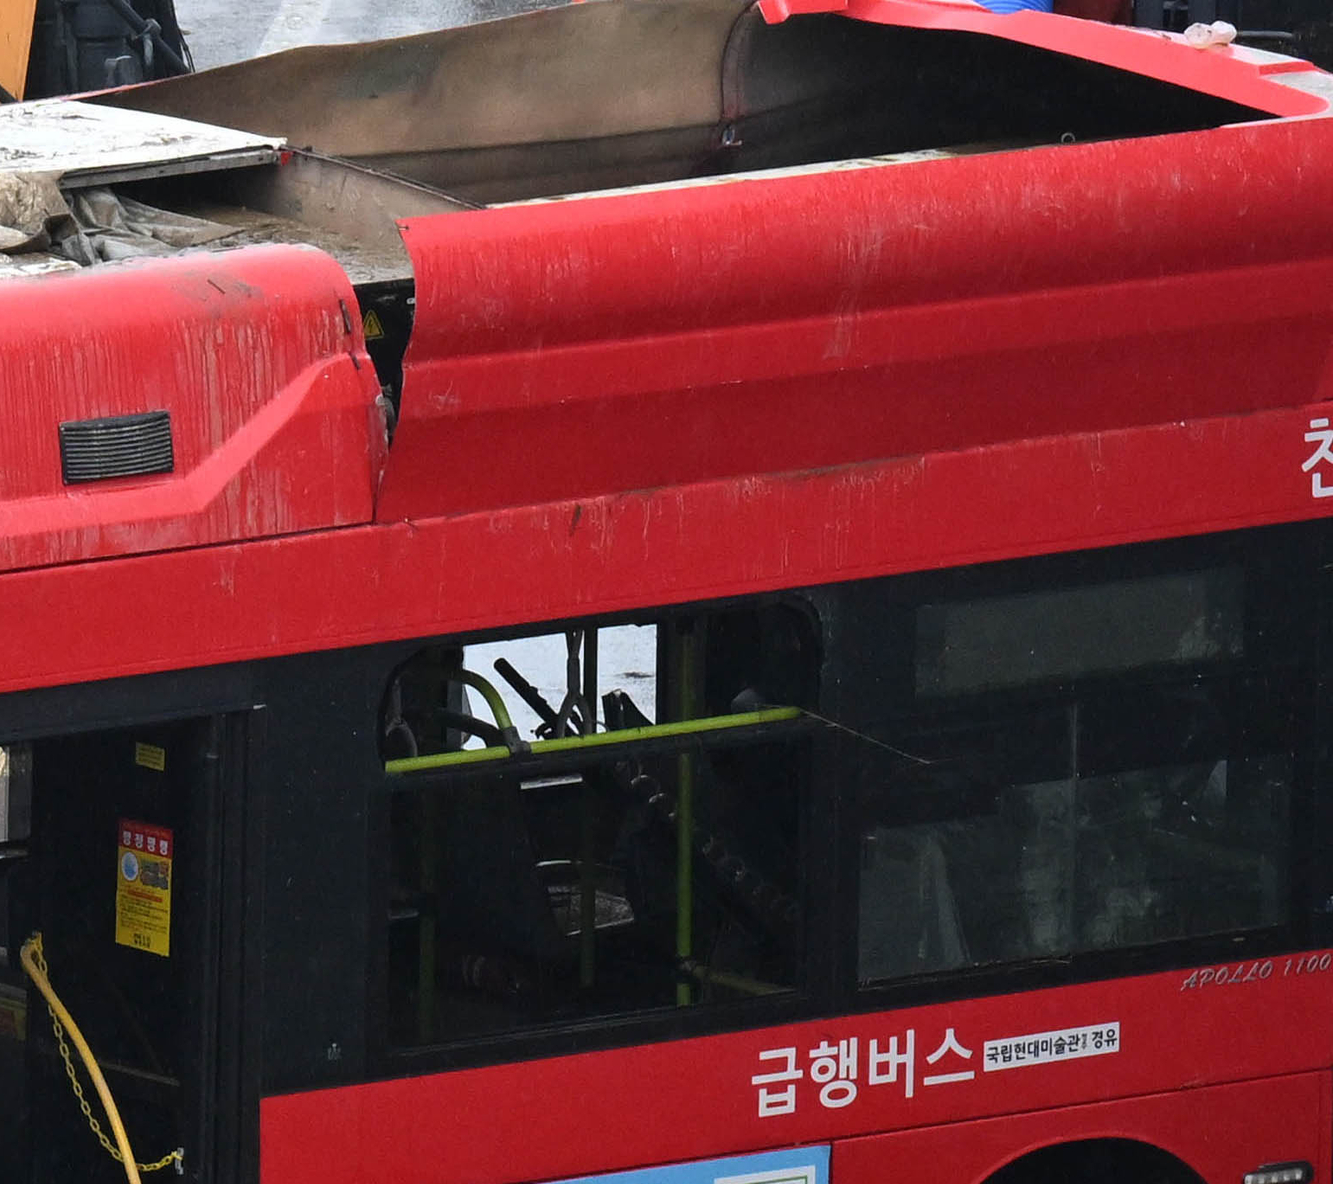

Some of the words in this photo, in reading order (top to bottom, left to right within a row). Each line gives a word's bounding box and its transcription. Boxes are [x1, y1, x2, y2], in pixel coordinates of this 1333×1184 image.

[1181, 960, 1273, 991] APOLLO
[1284, 953, 1331, 976] 1100
[1092, 1029, 1117, 1049] 경유
[751, 1027, 975, 1117] 급행버스
